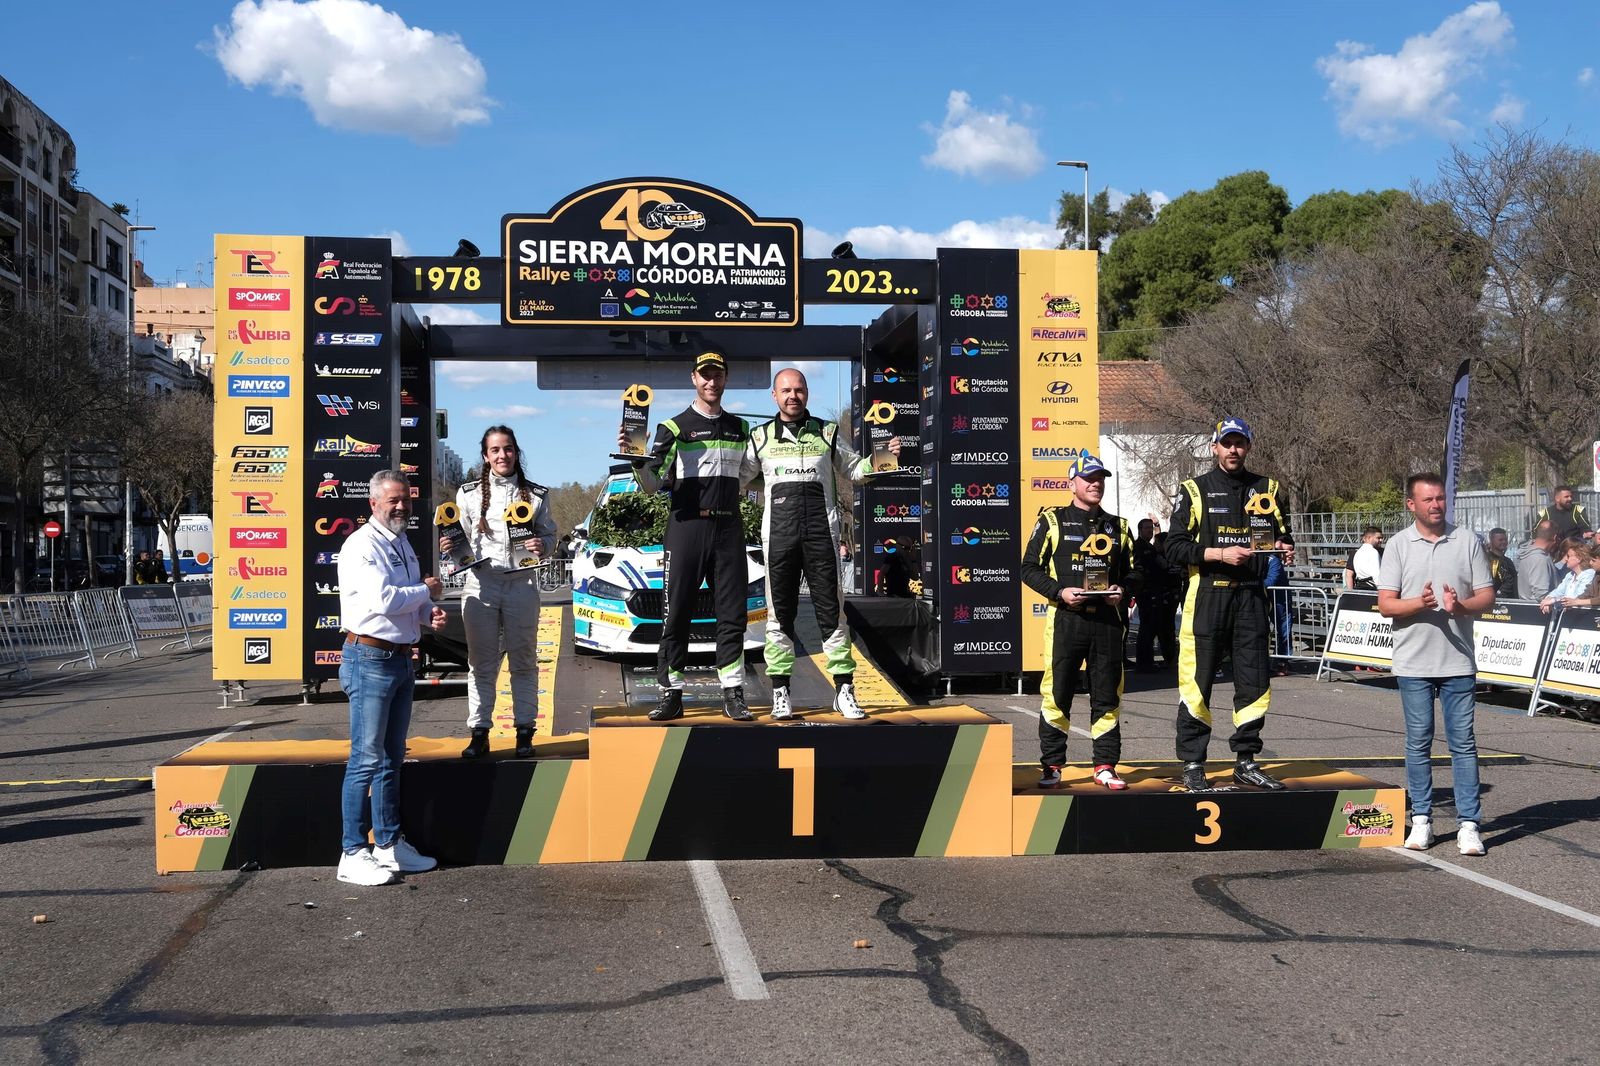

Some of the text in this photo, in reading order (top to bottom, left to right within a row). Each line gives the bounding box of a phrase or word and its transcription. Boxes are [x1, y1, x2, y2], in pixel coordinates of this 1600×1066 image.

[600, 189, 675, 241] 40
[519, 240, 786, 266] SIERRA MORENA
[519, 265, 728, 285] Rallye CÓRDOBA
[730, 269, 780, 277] PATRIMONIO
[415, 267, 481, 291] 1978
[730, 277, 786, 286] HUMANIDAD
[826, 269, 919, 295] 2023...
[236, 291, 281, 302] SPORMEX
[950, 308, 985, 317] CÓRDOBA
[1041, 329, 1077, 339] Recalvi
[247, 354, 290, 365] sadeco
[1037, 352, 1082, 362] KTVA
[232, 379, 286, 391] PINVECO
[971, 378, 1008, 386] Diputación
[971, 385, 1009, 393] de Córdoba
[620, 384, 653, 407] 40
[358, 401, 380, 410] MSi
[864, 402, 896, 425] 40
[248, 415, 268, 427] RG3
[972, 416, 1009, 424] AYUNTAMIENTO
[979, 422, 1003, 431] CÓRDOBA
[964, 452, 1009, 462] IMDECO
[1032, 448, 1078, 457] EMACSA
[951, 498, 986, 506] CÓRDOBA
[1244, 493, 1276, 515] 40
[433, 502, 460, 527] 40
[502, 501, 534, 525] 40
[177, 524, 209, 532] GENCIAS
[236, 530, 279, 540] SPORMEX
[1080, 533, 1112, 556] 40
[973, 567, 1010, 575] Diputación
[246, 589, 287, 599] sadeco
[233, 612, 283, 623] PINVECO
[577, 607, 595, 619] RACC
[981, 612, 1004, 620] CÓRDOBA
[1335, 622, 1393, 645] CÓRDOBA PATRI
[966, 641, 1011, 651] IMDECO
[1482, 636, 1526, 652] Diputación
[248, 645, 267, 657] RG3
[1478, 652, 1523, 667] de Córdoba
[1553, 659, 1585, 672] CÓRDOBA
[779, 748, 815, 836] 1
[1195, 800, 1221, 845] 3
